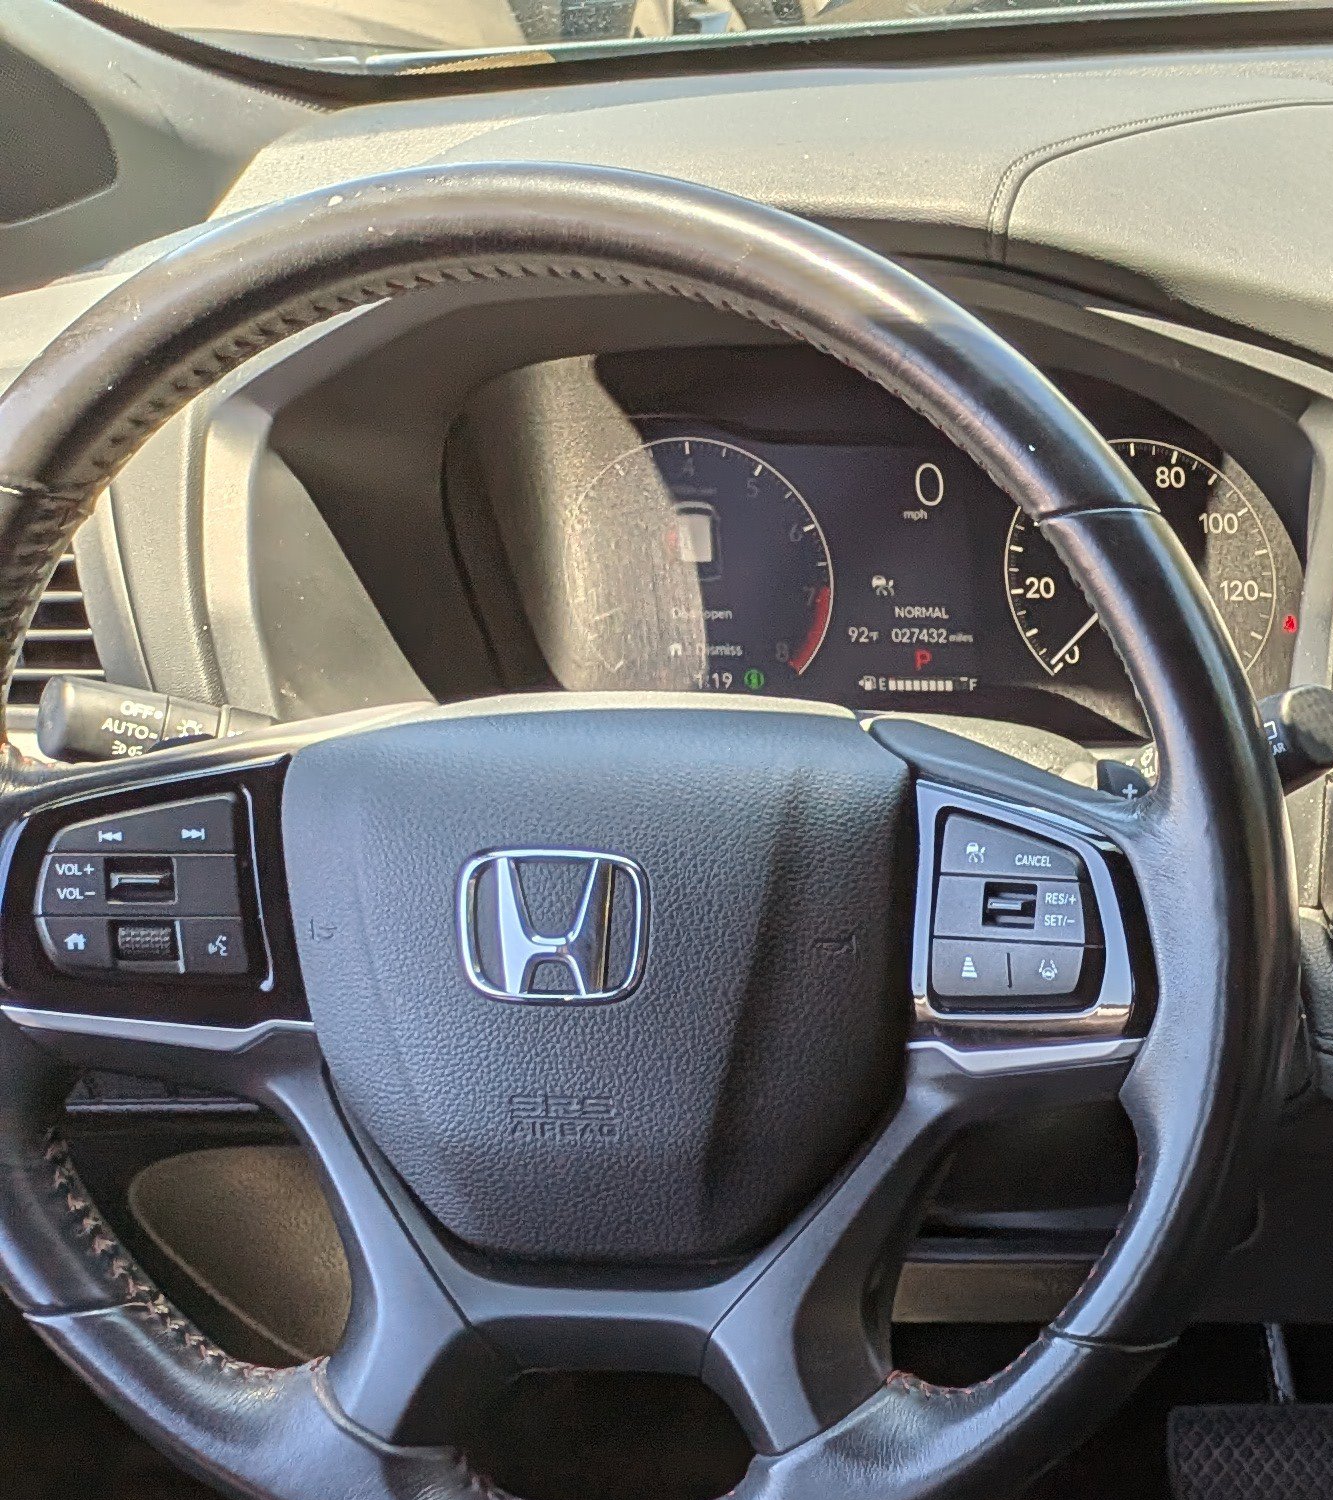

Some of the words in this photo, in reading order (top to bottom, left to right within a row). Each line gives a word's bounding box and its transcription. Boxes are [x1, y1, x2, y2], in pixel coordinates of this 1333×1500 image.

[915, 463, 944, 506] 0
[1156, 467, 1185, 488] 80
[903, 509, 927, 521] mph
[1199, 513, 1238, 534] 100
[1025, 577, 1055, 599] 20
[1220, 580, 1258, 601] 120
[895, 606, 949, 619] NORMAL
[891, 628, 947, 643] 027432
[914, 649, 932, 670] P
[120, 700, 153, 719] OFF
[101, 716, 150, 740] AUTO
[1015, 854, 1051, 867] CANCEL
